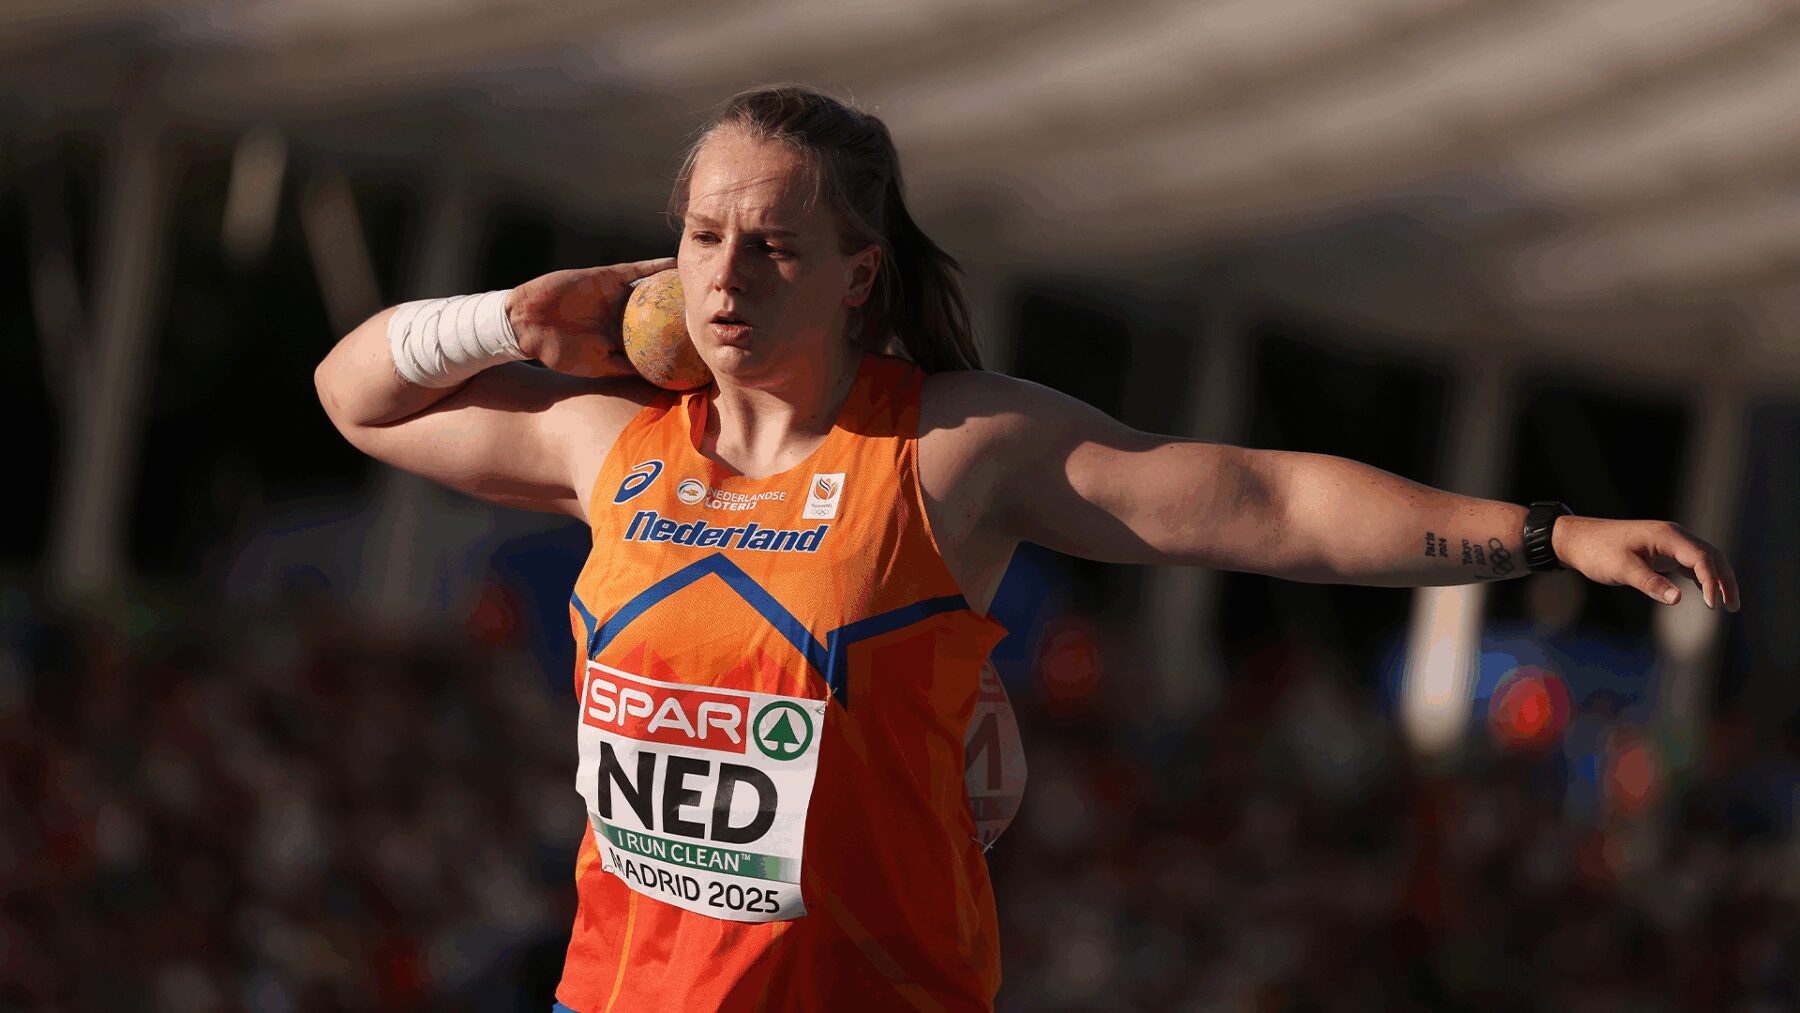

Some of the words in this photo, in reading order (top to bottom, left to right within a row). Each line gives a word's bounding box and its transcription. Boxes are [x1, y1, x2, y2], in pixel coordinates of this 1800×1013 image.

[705, 497, 757, 511] LOTERIJ
[709, 487, 787, 502] NEDERLANDSE
[1425, 531, 1435, 557] Paris
[589, 678, 742, 744] SPAR
[598, 740, 778, 844] NED
[618, 830, 623, 846] I
[627, 833, 666, 859] RUN
[609, 847, 700, 901] MADRID
[708, 881, 780, 914] 2025
